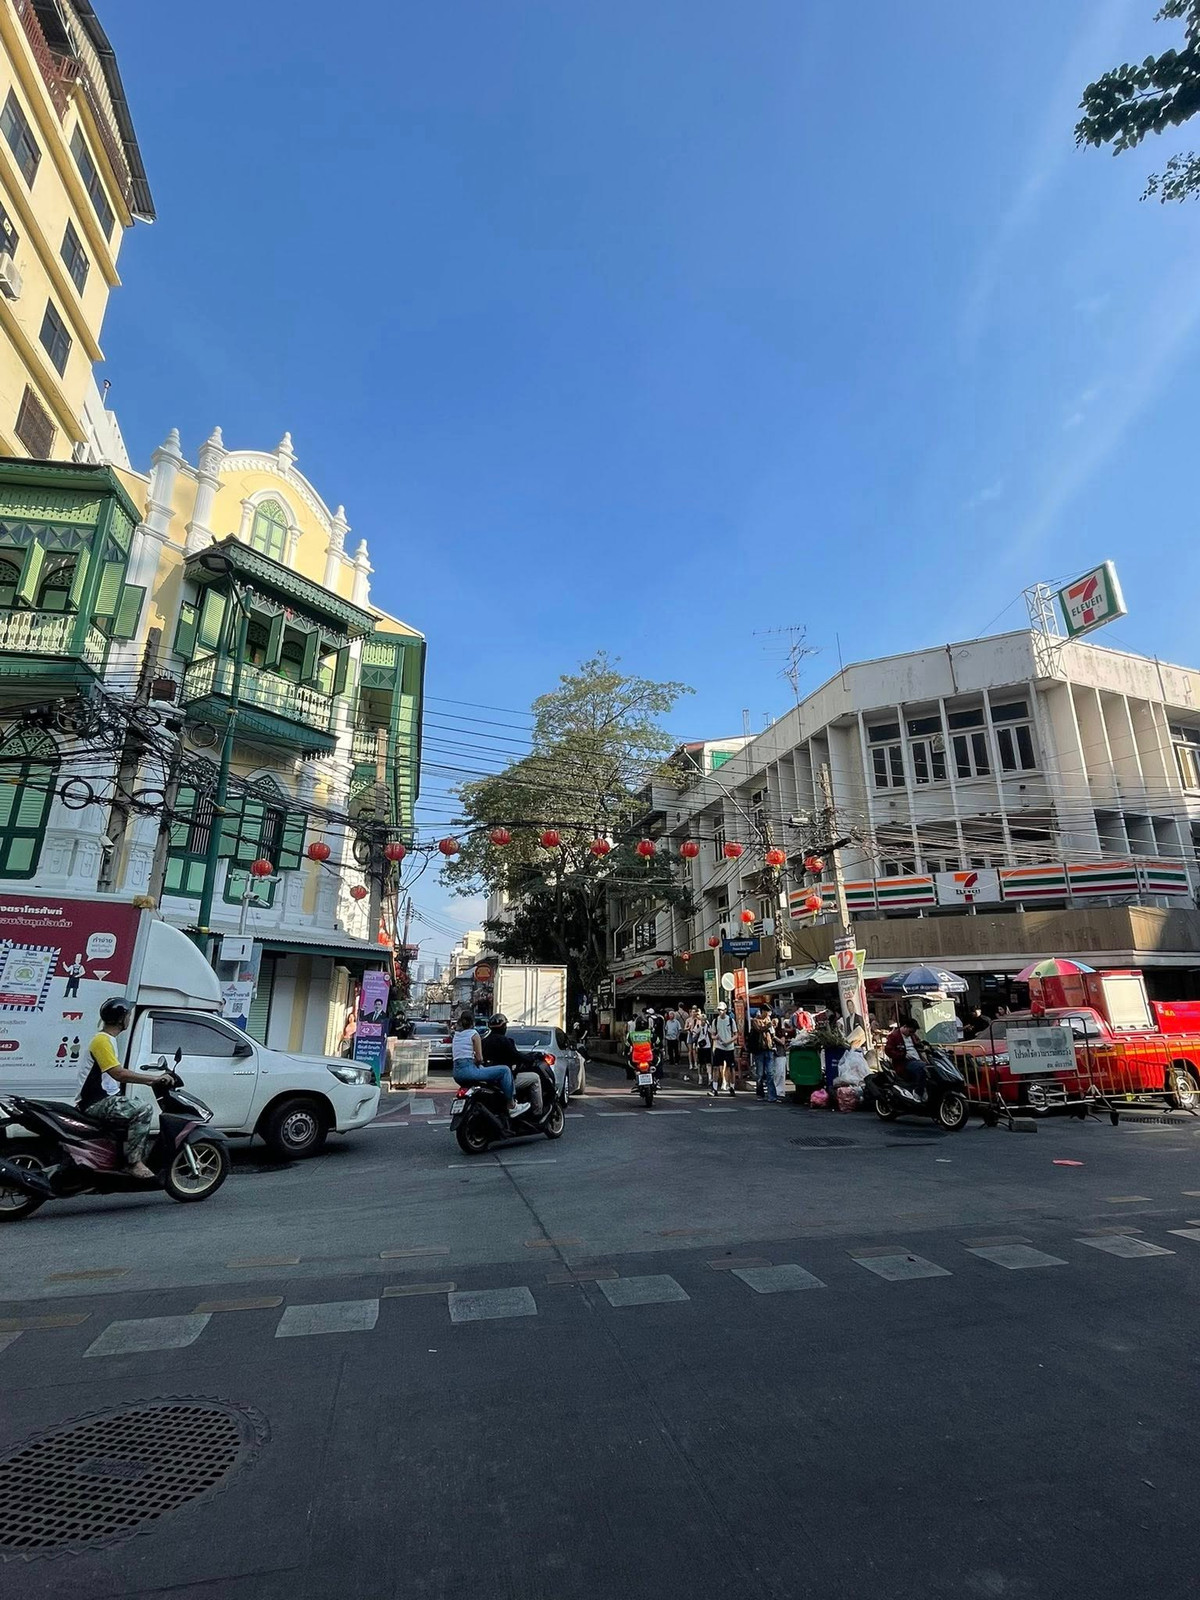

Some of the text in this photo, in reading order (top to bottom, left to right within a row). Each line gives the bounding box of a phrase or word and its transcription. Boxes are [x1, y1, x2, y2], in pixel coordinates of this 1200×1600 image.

[1068, 575, 1098, 625] 7
[953, 871, 979, 903] 7
[837, 950, 855, 970] 12
